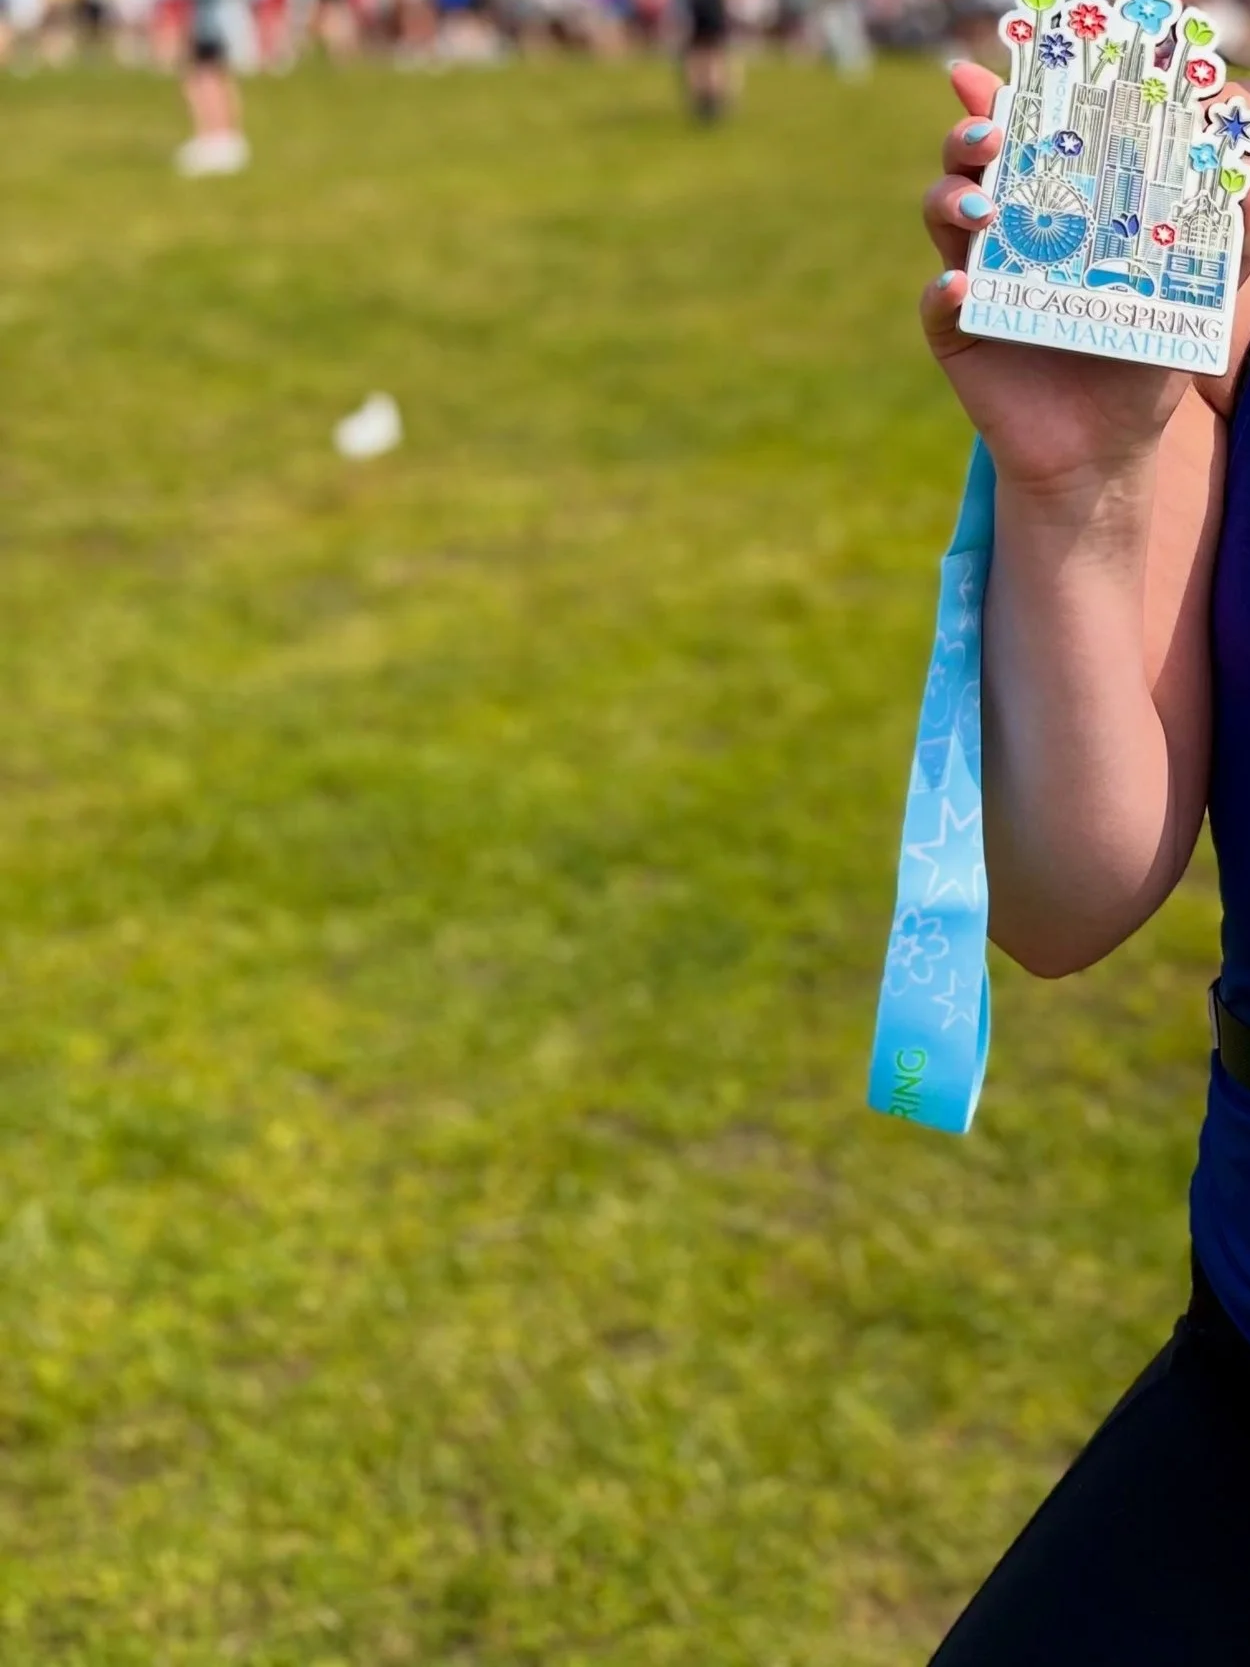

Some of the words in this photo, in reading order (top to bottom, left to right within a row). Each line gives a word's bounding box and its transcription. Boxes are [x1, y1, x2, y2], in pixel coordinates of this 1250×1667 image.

[970, 303, 1045, 335] HALF
[1053, 320, 1220, 365] MARATHON
[971, 278, 1112, 321] CHICAGO
[1114, 301, 1223, 341] SPRING
